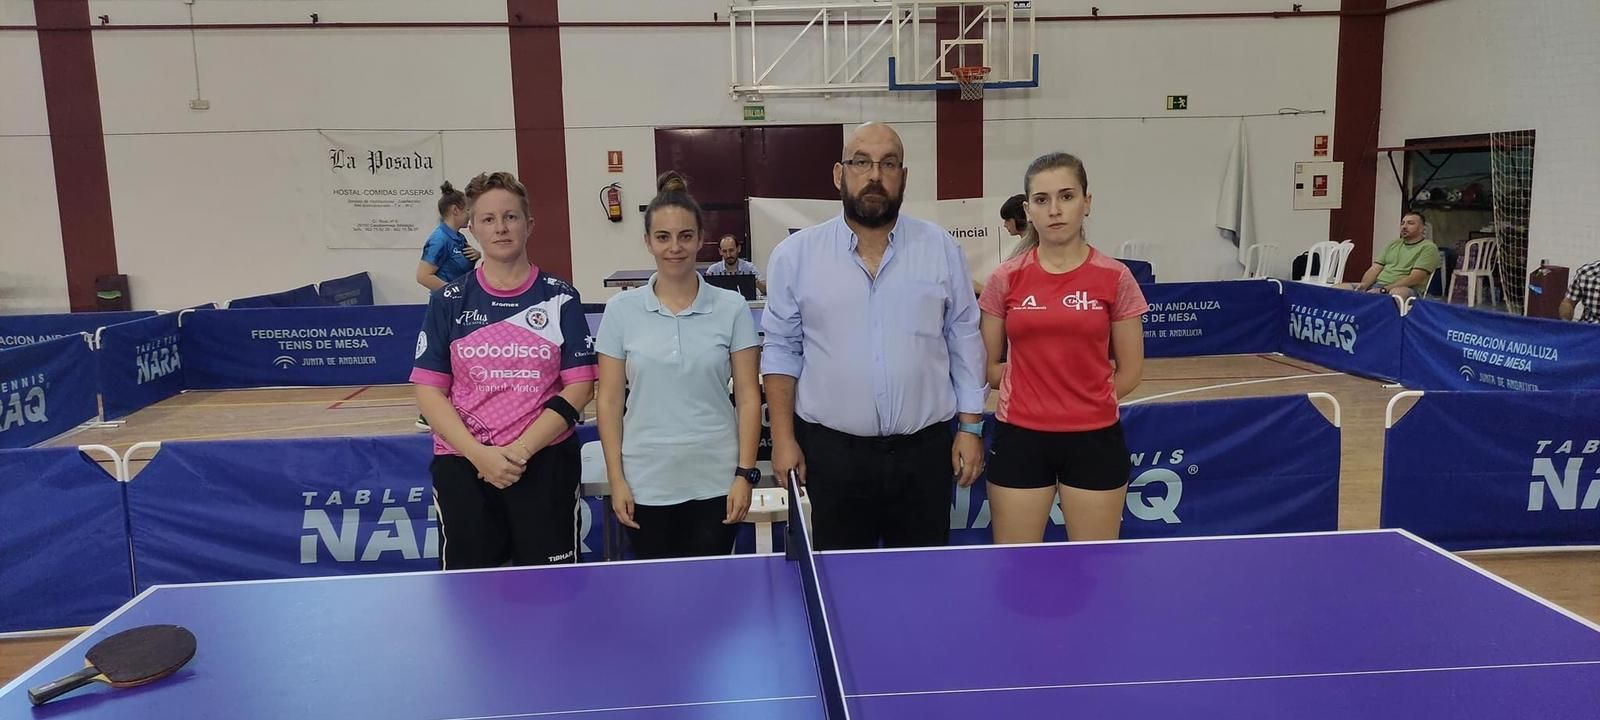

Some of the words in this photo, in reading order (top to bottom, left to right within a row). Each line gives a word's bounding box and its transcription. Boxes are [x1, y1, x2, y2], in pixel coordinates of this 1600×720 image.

[330, 149, 356, 174] La
[367, 150, 433, 175] Posada
[1165, 301, 1221, 311] ANDALUZA
[1290, 304, 1318, 316] TABLE
[1321, 310, 1355, 323] TENNIS
[463, 309, 488, 325] Plus
[1151, 314, 1165, 323] DE
[1168, 312, 1197, 322] MESA
[251, 328, 328, 339] FEDERACION
[330, 326, 394, 338] ANDALUZA
[1289, 313, 1357, 354] NARAQ
[278, 340, 313, 350] TENIS
[316, 340, 332, 349] DE
[335, 339, 369, 349] MESA
[1447, 329, 1506, 352] FEDERACION
[1506, 341, 1558, 361] ANDALUZA
[1462, 347, 1489, 363] TENIS
[1489, 353, 1504, 366] DE
[1504, 356, 1532, 373] MESA
[490, 370, 541, 379] mazda
[302, 487, 424, 506] TABLE
[548, 550, 573, 562] TIBHAR
